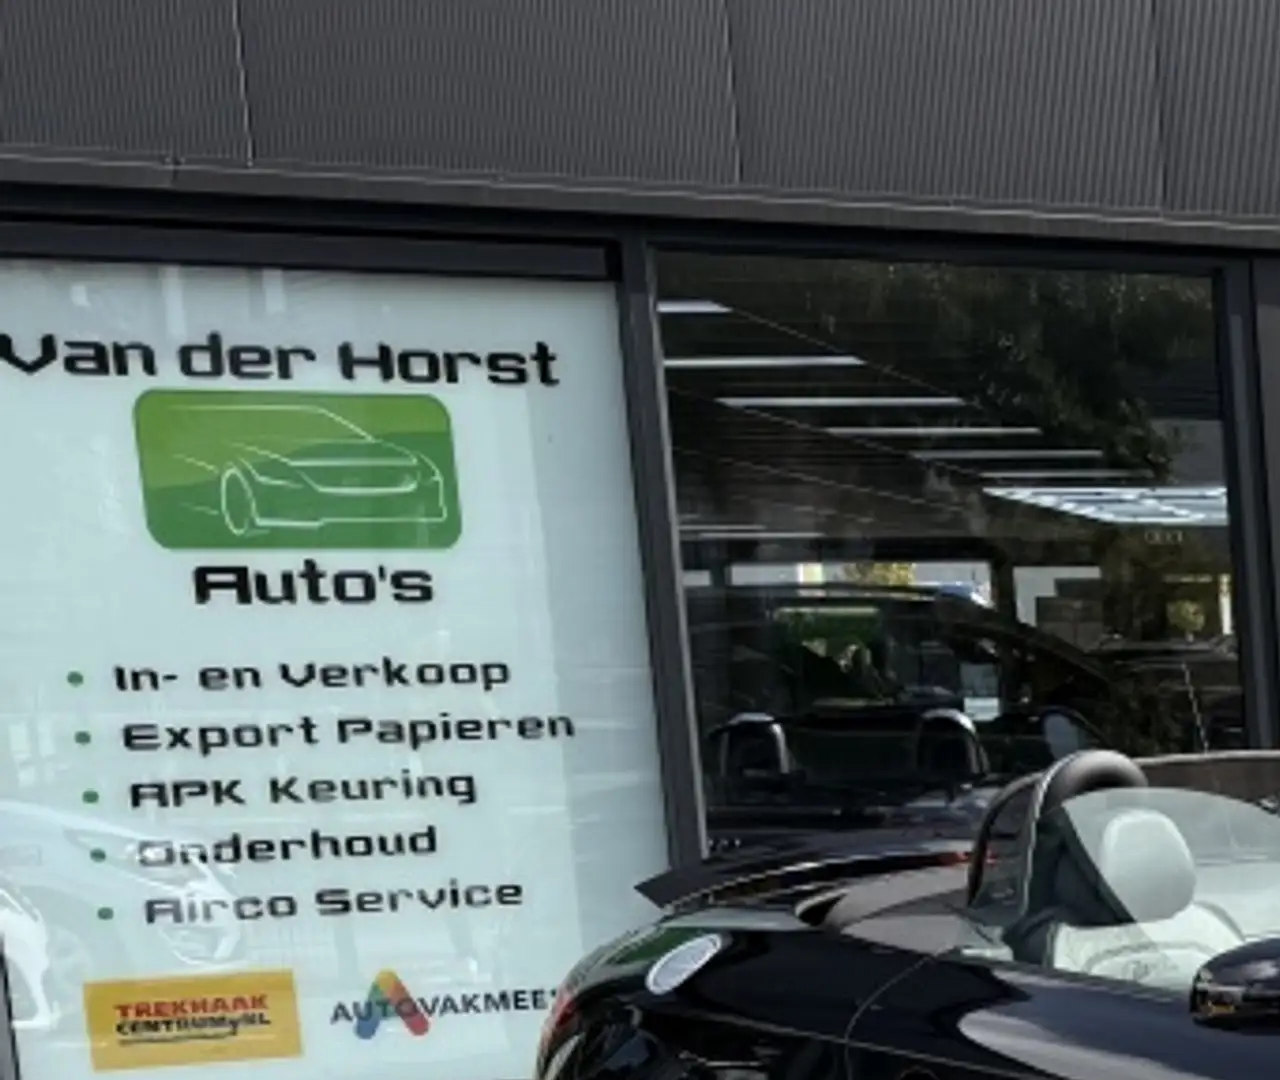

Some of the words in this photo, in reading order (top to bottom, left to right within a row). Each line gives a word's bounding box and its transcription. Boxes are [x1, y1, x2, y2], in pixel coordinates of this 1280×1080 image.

[0, 333, 157, 377] Van
[178, 331, 316, 380] der
[338, 341, 560, 386] Horst
[193, 559, 434, 605] Auto's
[113, 664, 179, 692] In-
[199, 664, 262, 690] en
[279, 656, 512, 692] Verkoop
[122, 717, 320, 756] Export
[337, 713, 576, 751] Papieren
[130, 778, 246, 809] APK
[269, 771, 477, 805] Keuring
[138, 826, 438, 867] Onderhoud
[145, 892, 298, 924] Airco
[315, 879, 523, 915] Service
[113, 994, 270, 1020] TREKHAAK
[330, 988, 557, 1025] AUTOVAKMEE
